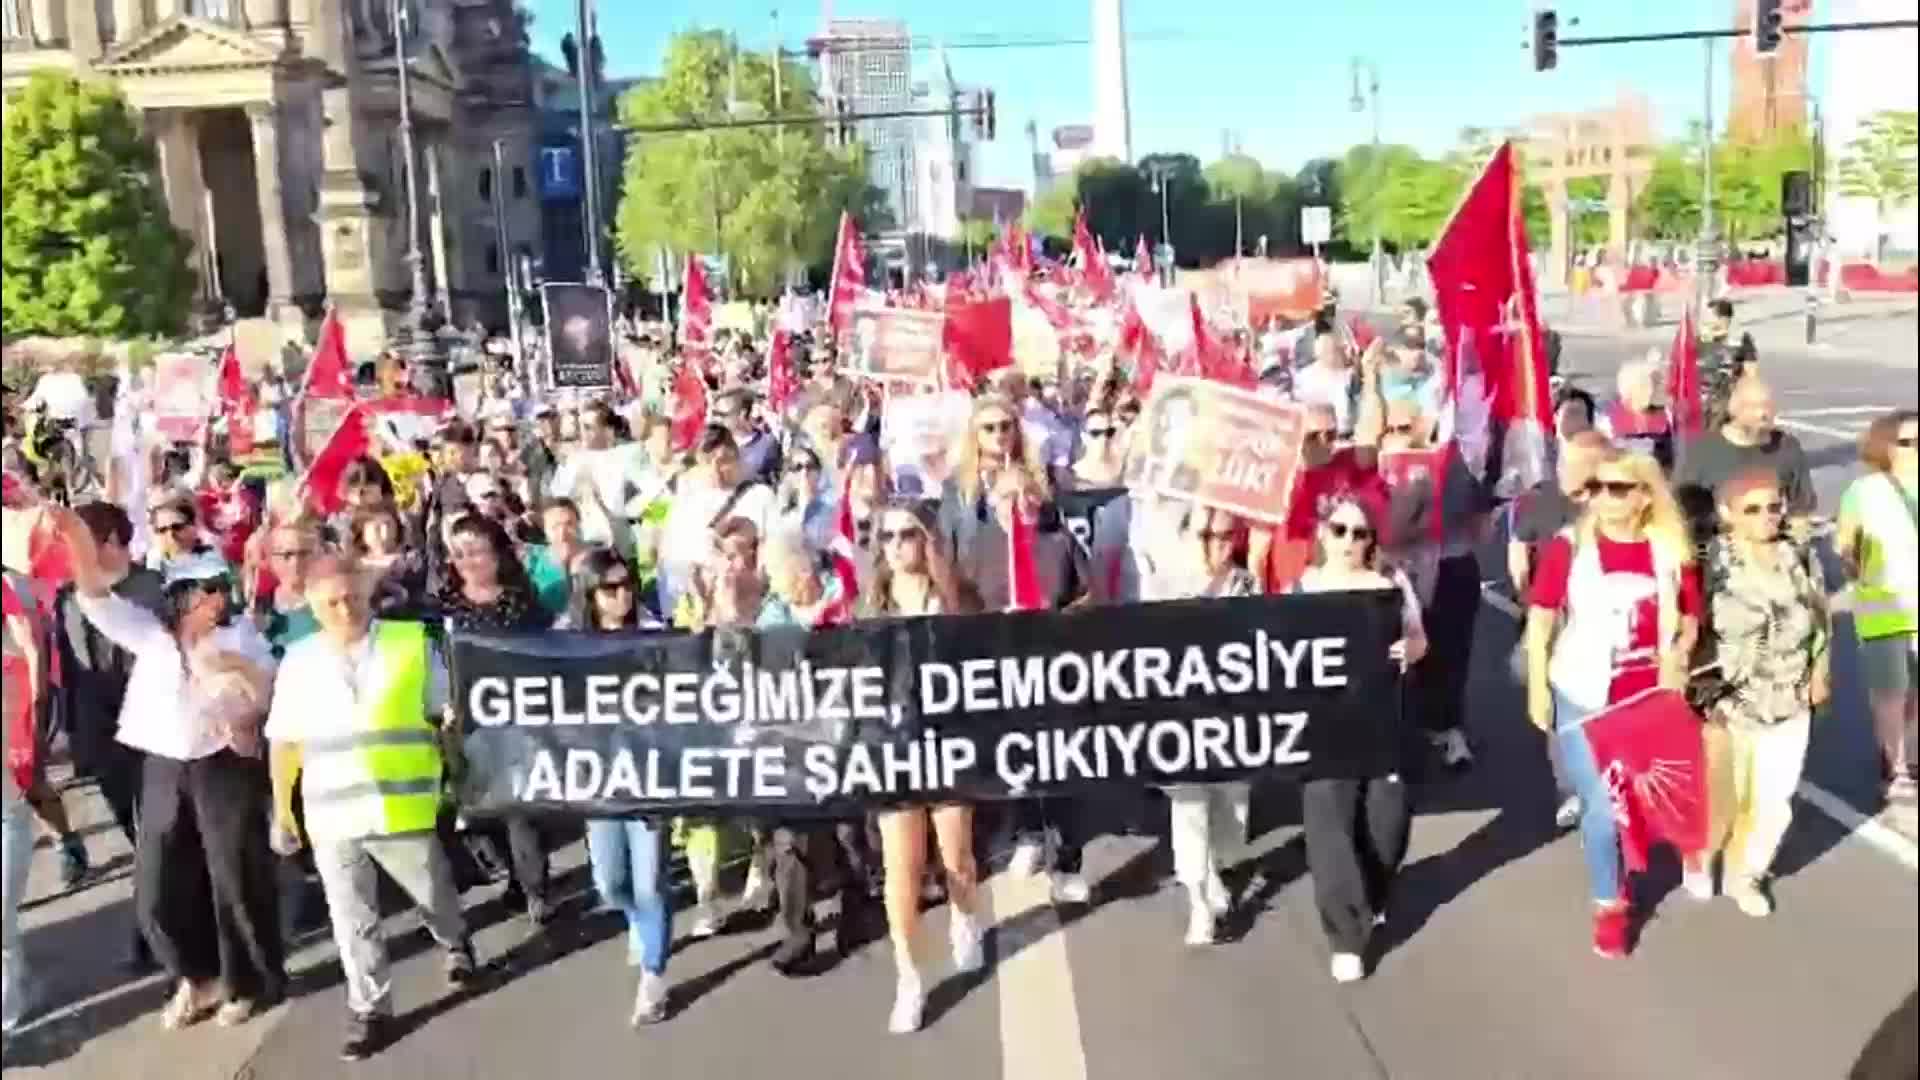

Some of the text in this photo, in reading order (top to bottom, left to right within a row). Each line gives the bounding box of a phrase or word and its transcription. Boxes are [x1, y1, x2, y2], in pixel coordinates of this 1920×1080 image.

[920, 628, 1349, 715] DEMOKRASİYE
[521, 744, 788, 802] ADALETE
[995, 710, 1312, 796] ÇIKIYORUZ
